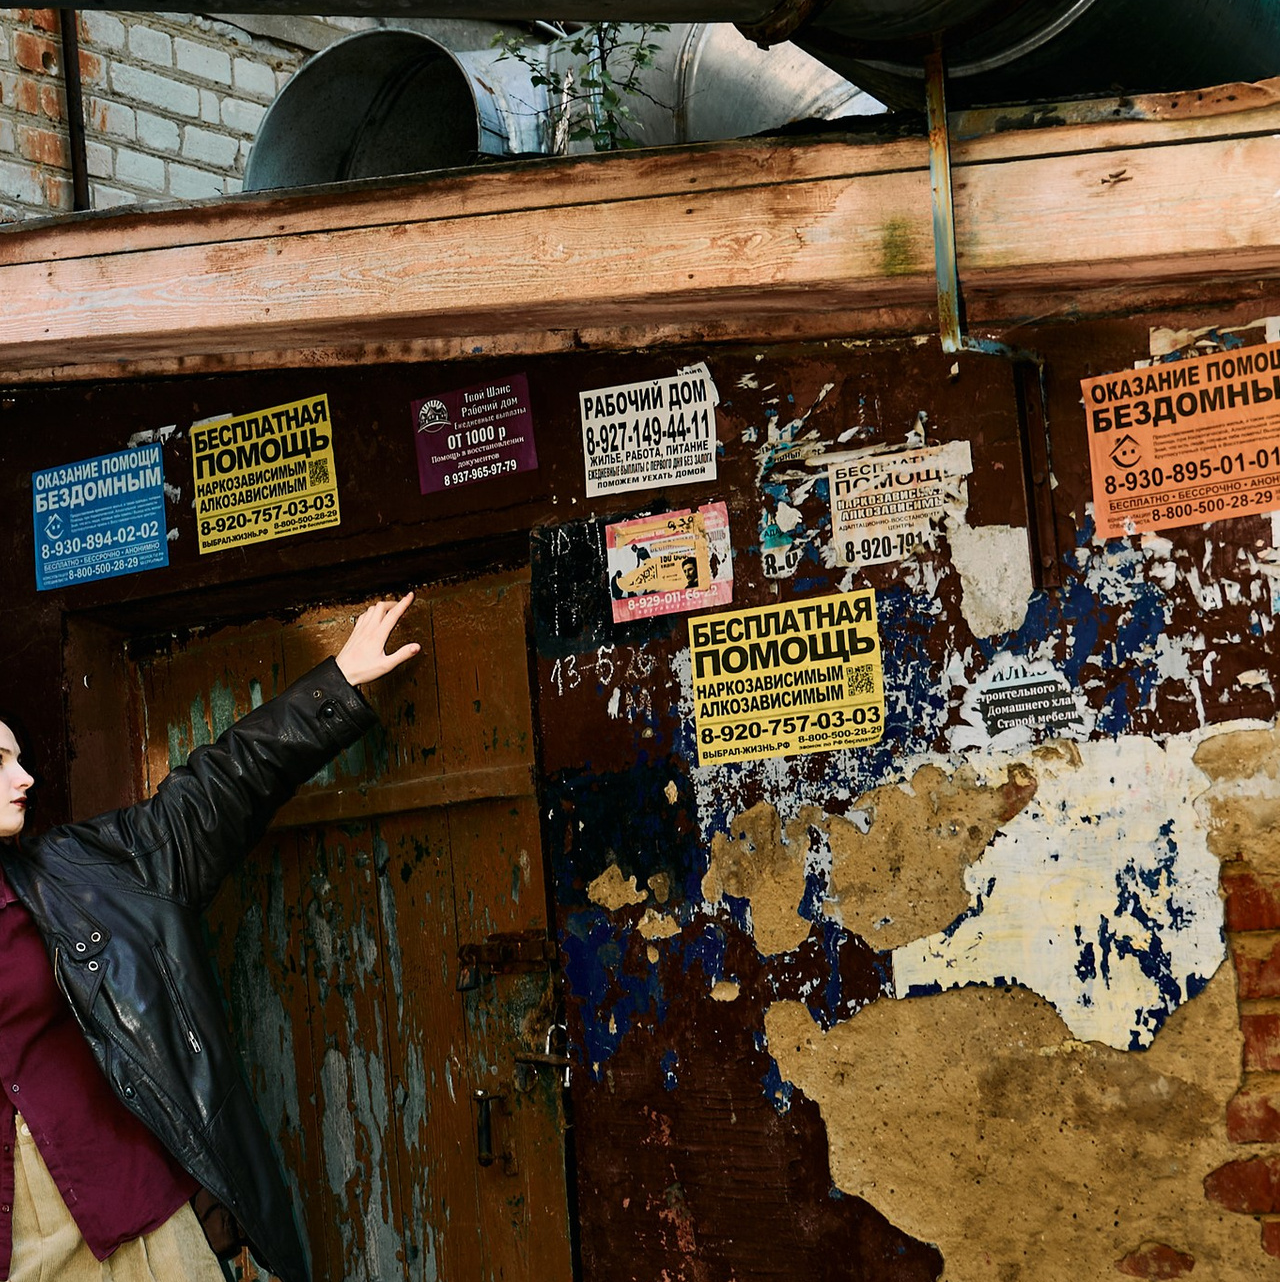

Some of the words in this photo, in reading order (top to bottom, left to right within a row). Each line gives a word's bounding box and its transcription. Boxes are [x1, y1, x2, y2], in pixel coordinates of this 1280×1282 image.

[464, 390, 485, 404] Твой
[486, 384, 511, 398] Шанс
[584, 381, 663, 420] РАБОЧИЙ
[669, 379, 707, 411] ДОМ
[1091, 365, 1200, 404] ОКАЗАНИЕ
[461, 399, 498, 417] Рабочий
[501, 397, 518, 410] дом
[1092, 376, 1280, 433] БЕЗДОМНЫ
[193, 400, 328, 453] БЕСПЛАТНАЯ
[447, 433, 462, 450] ОТ
[465, 425, 495, 446] 1000
[586, 409, 709, 456] 8-927-149-44-11
[196, 428, 329, 480] ПОМОЩЬ
[431, 449, 461, 464] Помощь
[467, 436, 525, 456] восстановлении
[457, 453, 500, 469] документов
[590, 452, 624, 467] ЖИЛЬЕ,
[625, 447, 663, 462] РАБОТА,
[666, 440, 709, 456] ПИТАНИЕ
[684, 455, 694, 466] БЕЗ
[36, 462, 98, 490] ОКАЗАНИЕ
[102, 447, 159, 475] ПОМОЩИ
[197, 460, 307, 498] НАРКОЗАВИСИМЫМ
[444, 475, 451, 486] 8
[453, 459, 517, 485] 937-965-97-79
[597, 476, 640, 489] ПОМОЖЕМ
[642, 472, 673, 483] УЕХАТЬ
[675, 467, 706, 478] ДОМОЙ
[1104, 446, 1280, 495] 8-930-895-01-01
[35, 467, 161, 513] БЕЗДОМНЫМ
[200, 476, 307, 514] АЛКОЗАВИСИМЫМ
[1109, 494, 1170, 511] БЕСПЛАТНО
[1178, 482, 1241, 499] БЕССРОЧНО
[1250, 474, 1280, 488] АНОН
[1152, 490, 1273, 521] 8-800-500-28-29
[201, 493, 335, 536] 8-920-757-03-03
[274, 510, 337, 529] 8-800-500-28-29
[42, 520, 159, 559] 8-930-894-02-02
[202, 529, 269, 548] ВЫБРАЛ-ЖИЗНЬ.РФ
[44, 559, 80, 572] БЕСПЛАТНО
[84, 550, 120, 563] БЕССРОЧНО
[125, 542, 160, 555] АНОНИМНО
[68, 556, 138, 580] 8-800-500-28-29
[693, 597, 872, 648] БЕСПЛАТНАЯ
[695, 628, 875, 678] ПОМОЩЬ
[697, 665, 844, 700] НАРКОЗАВИСИМЫМ
[700, 684, 844, 718] АЛКОЗАВИСИМЫМ
[988, 698, 1050, 717] Домашнего
[1052, 696, 1075, 707] хла
[701, 706, 880, 744] 8-920-757-03-03
[798, 726, 882, 743] 8-800-500-28-29
[997, 714, 1036, 729] Старой
[1038, 710, 1079, 724] мебели
[702, 741, 790, 759] ВЫБРАЛ-ЖИЗНЬ.РФ
